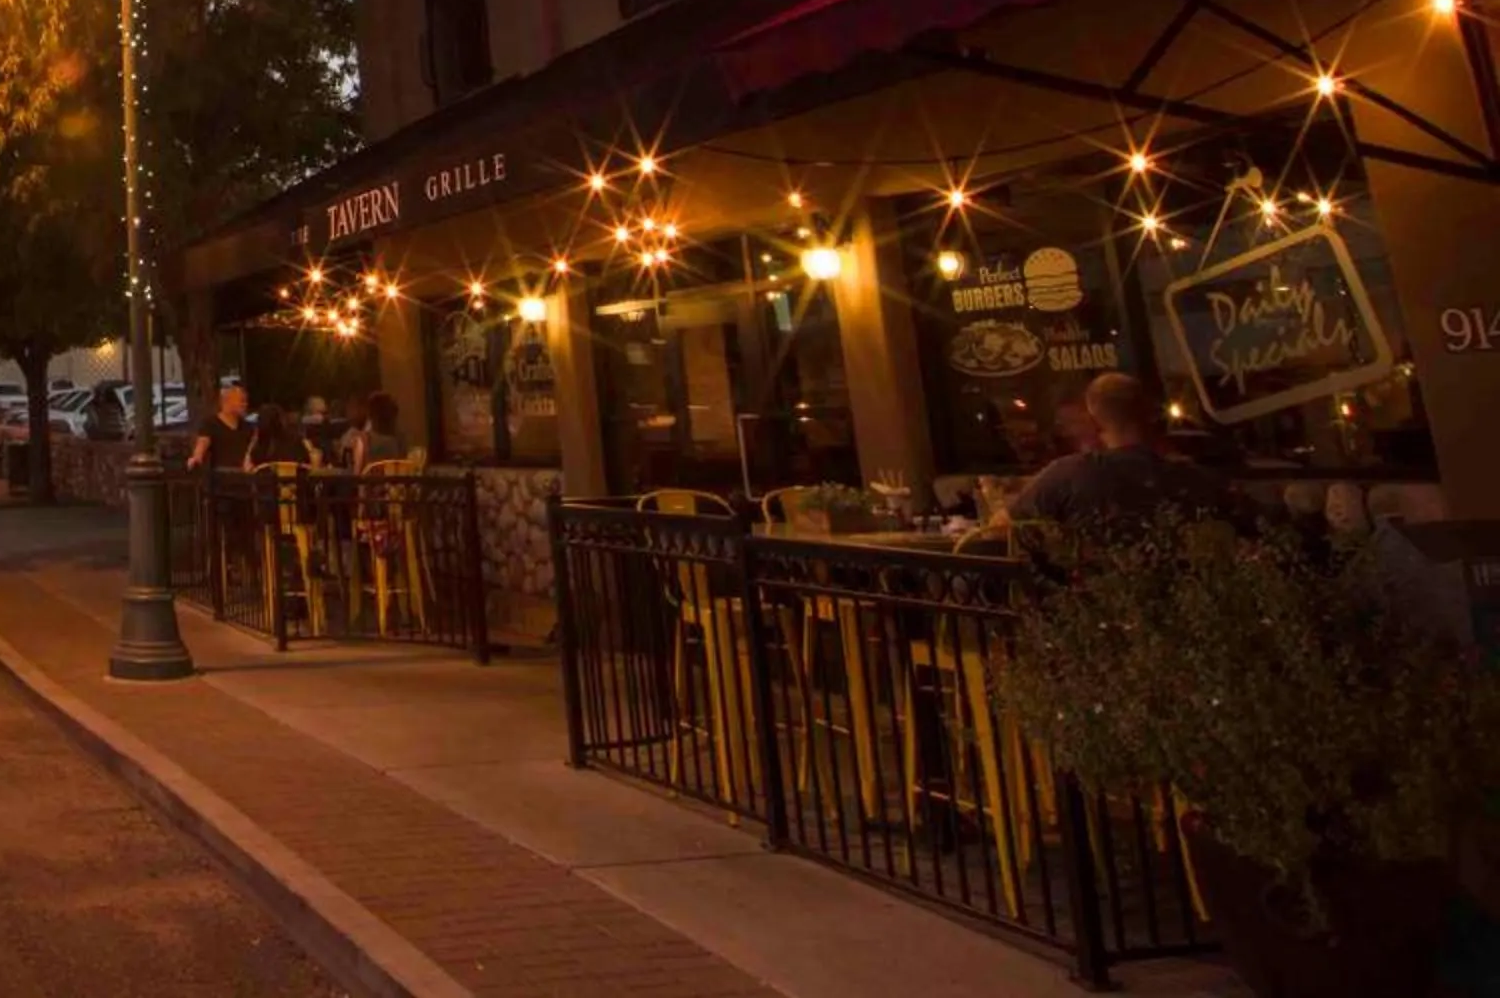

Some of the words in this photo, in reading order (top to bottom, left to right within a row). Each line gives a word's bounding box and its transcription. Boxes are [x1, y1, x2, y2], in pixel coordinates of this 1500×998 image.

[327, 181, 400, 241] TAVERN
[425, 153, 506, 202] GRILLE
[951, 281, 1026, 313] BURGERS
[1205, 264, 1315, 335] Daily
[1048, 342, 1118, 372] SALADS
[1209, 301, 1353, 396] Specials
